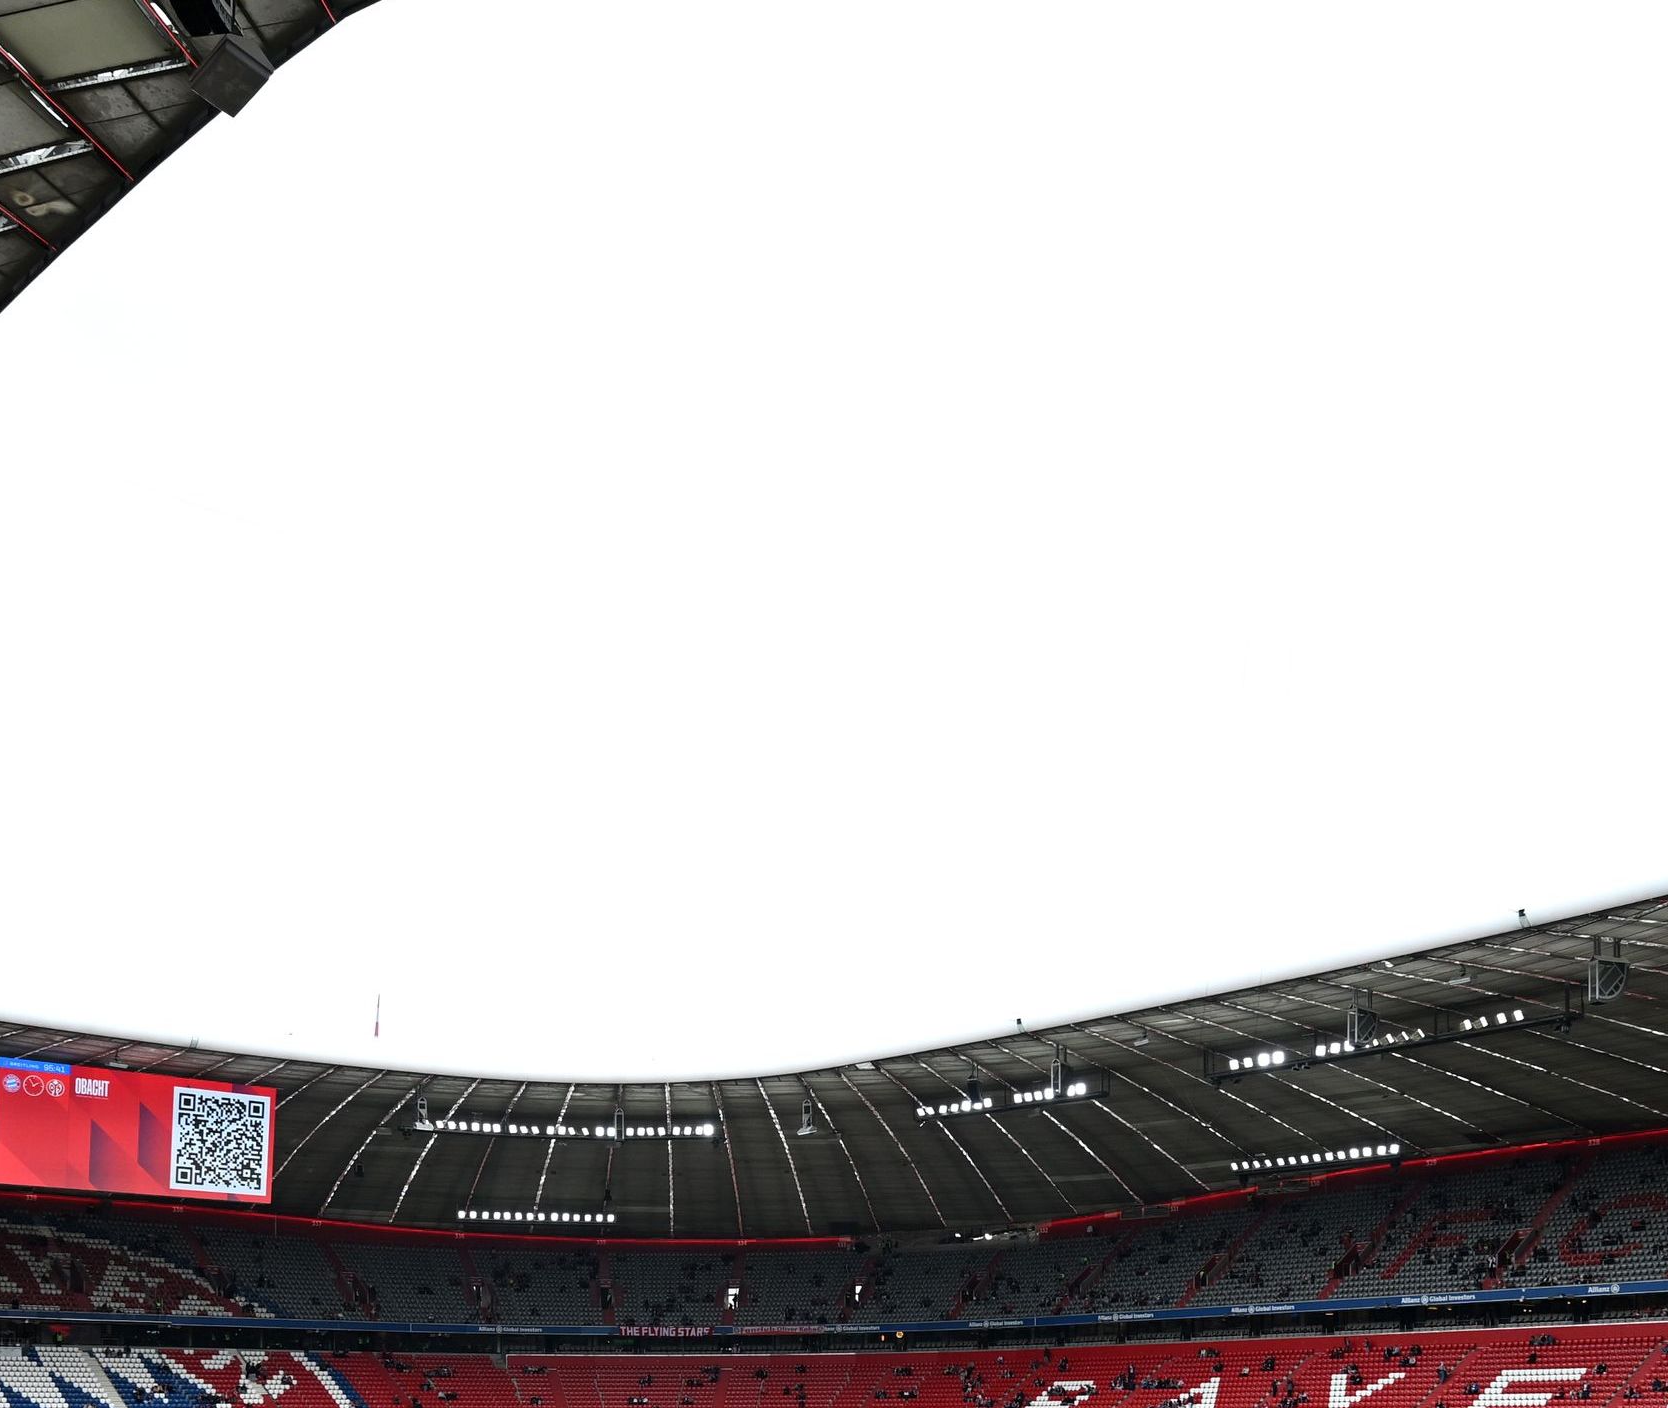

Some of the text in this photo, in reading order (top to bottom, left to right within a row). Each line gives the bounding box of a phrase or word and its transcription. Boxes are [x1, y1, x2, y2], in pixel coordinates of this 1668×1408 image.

[75, 1077, 110, 1097] OBACHT
[620, 1326, 640, 1336] THE
[642, 1326, 676, 1336] FLYING
